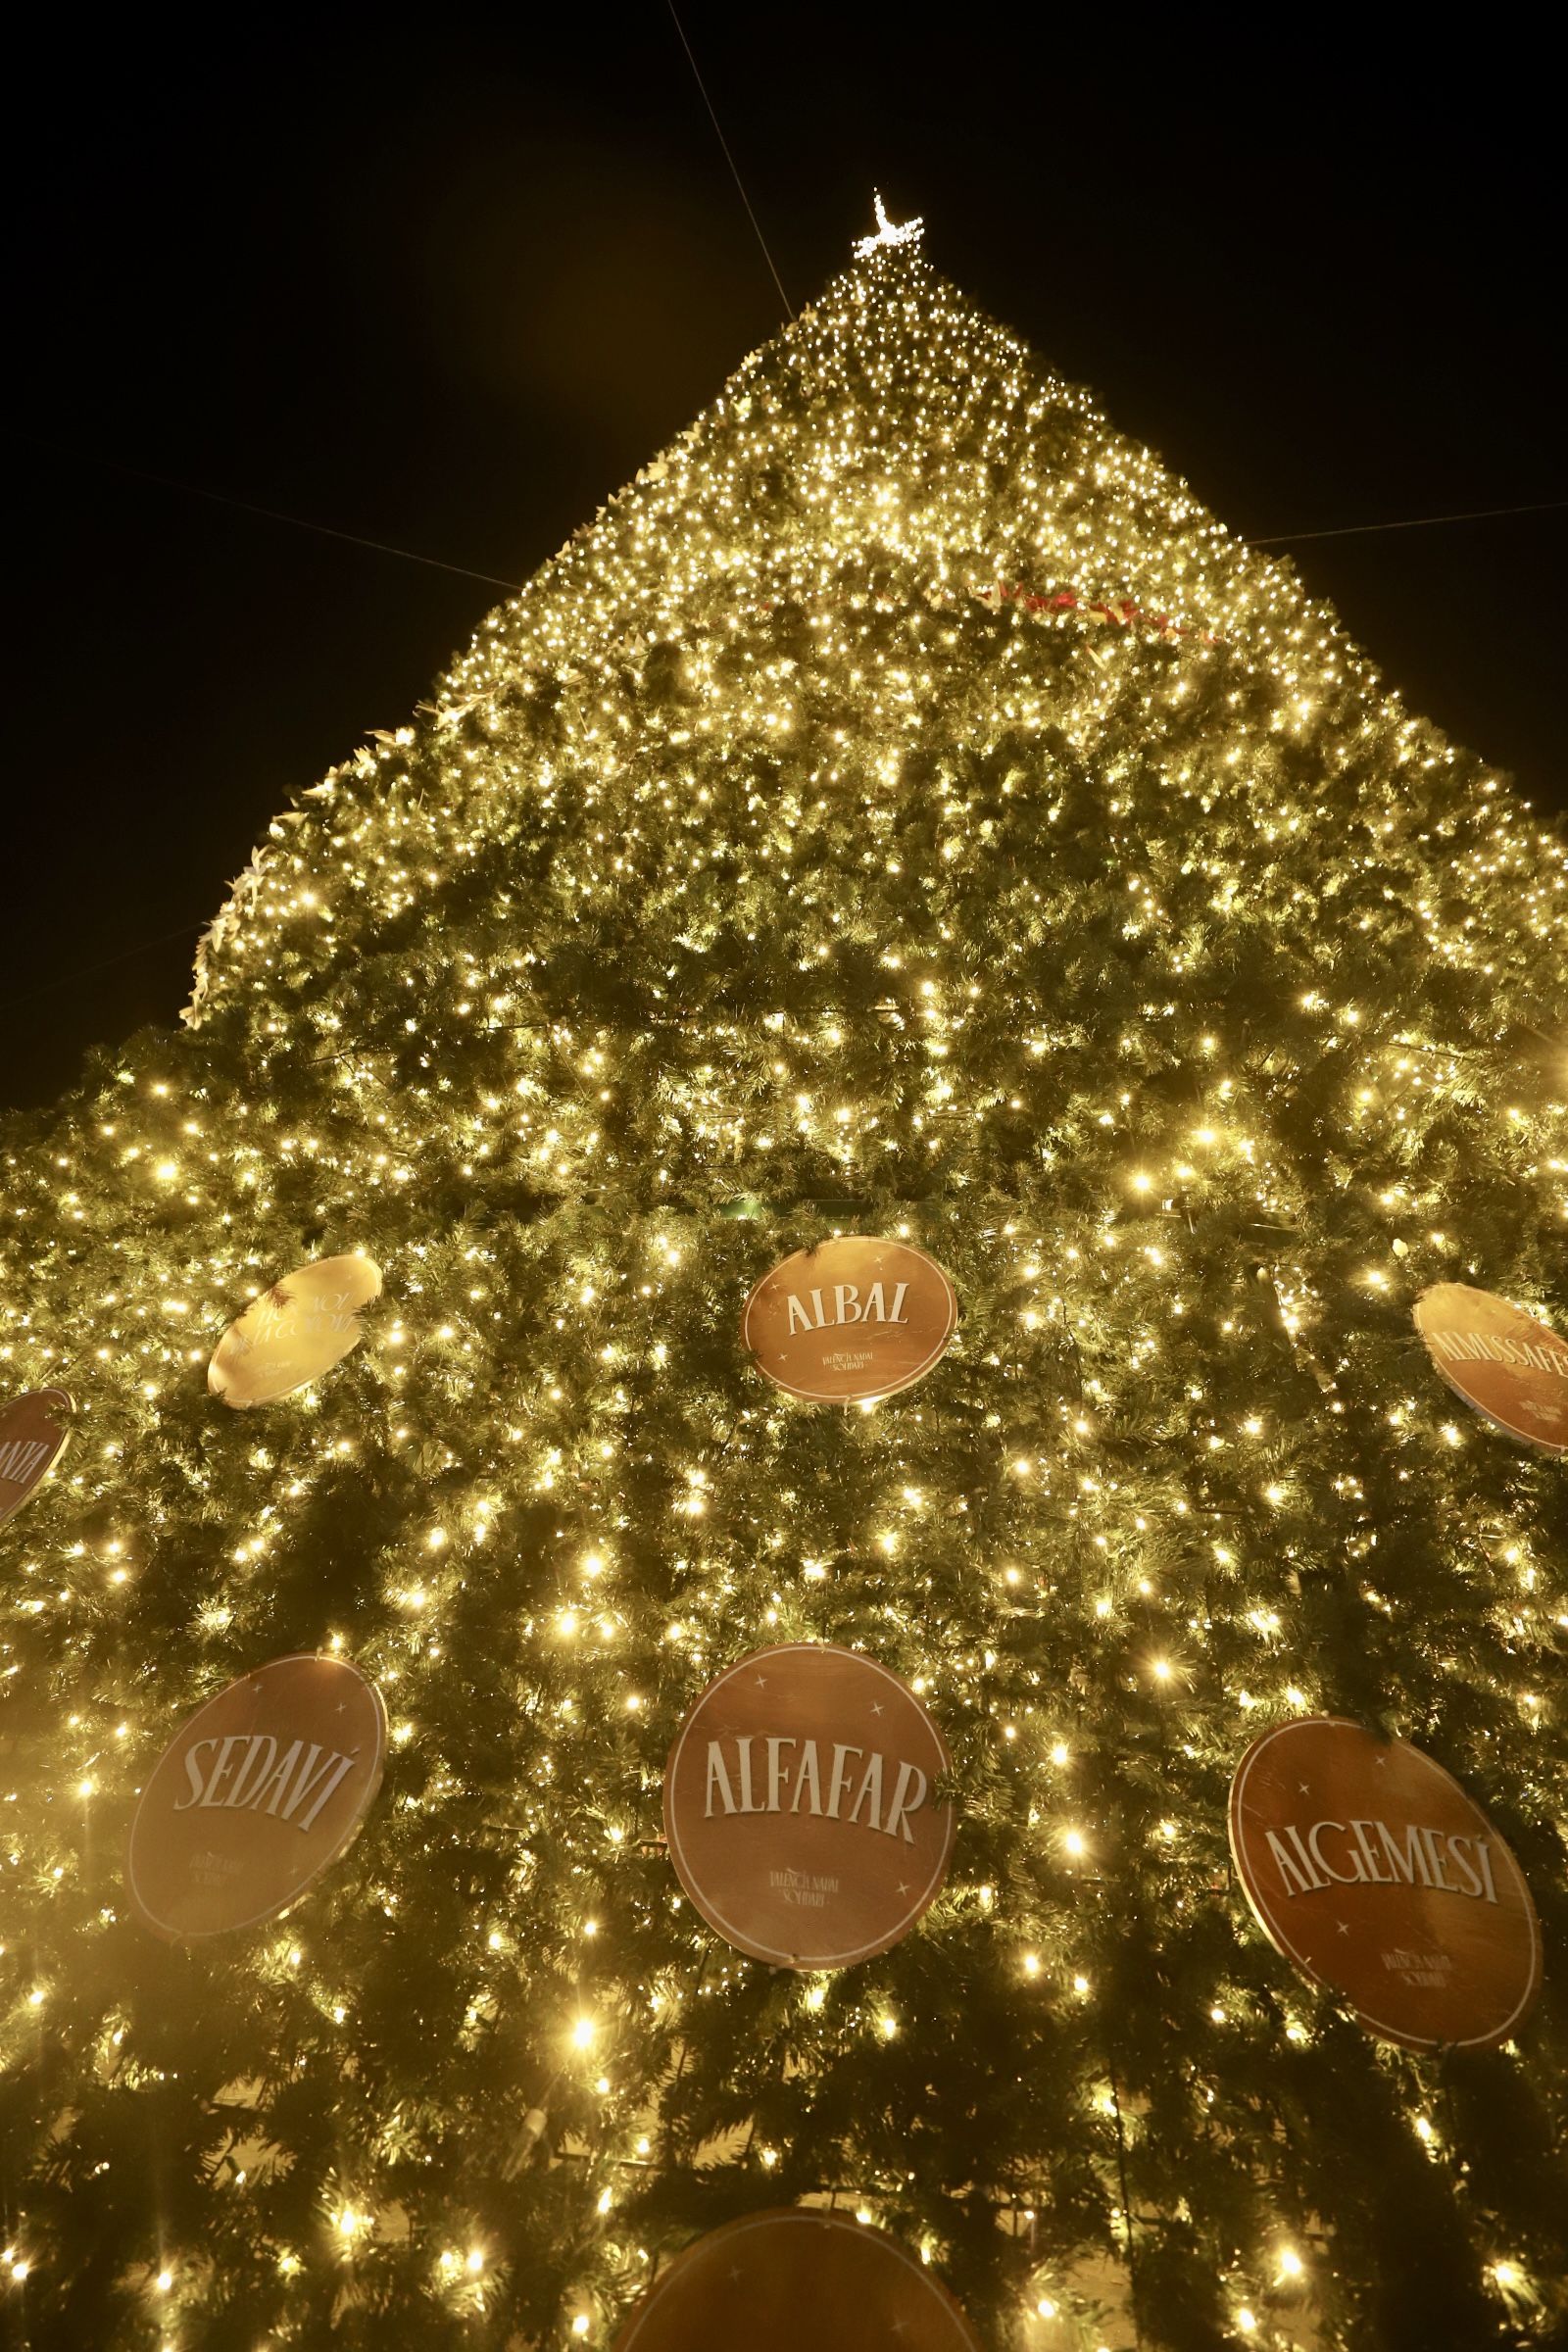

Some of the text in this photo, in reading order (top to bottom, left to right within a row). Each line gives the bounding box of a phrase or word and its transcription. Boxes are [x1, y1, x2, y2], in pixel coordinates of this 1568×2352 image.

[787, 1282, 909, 1336] ALBAL
[172, 1735, 361, 1833] SEDAVÍ
[704, 1737, 927, 1844] ALFAFAR
[1265, 1819, 1498, 1903] ALGEMESÍ
